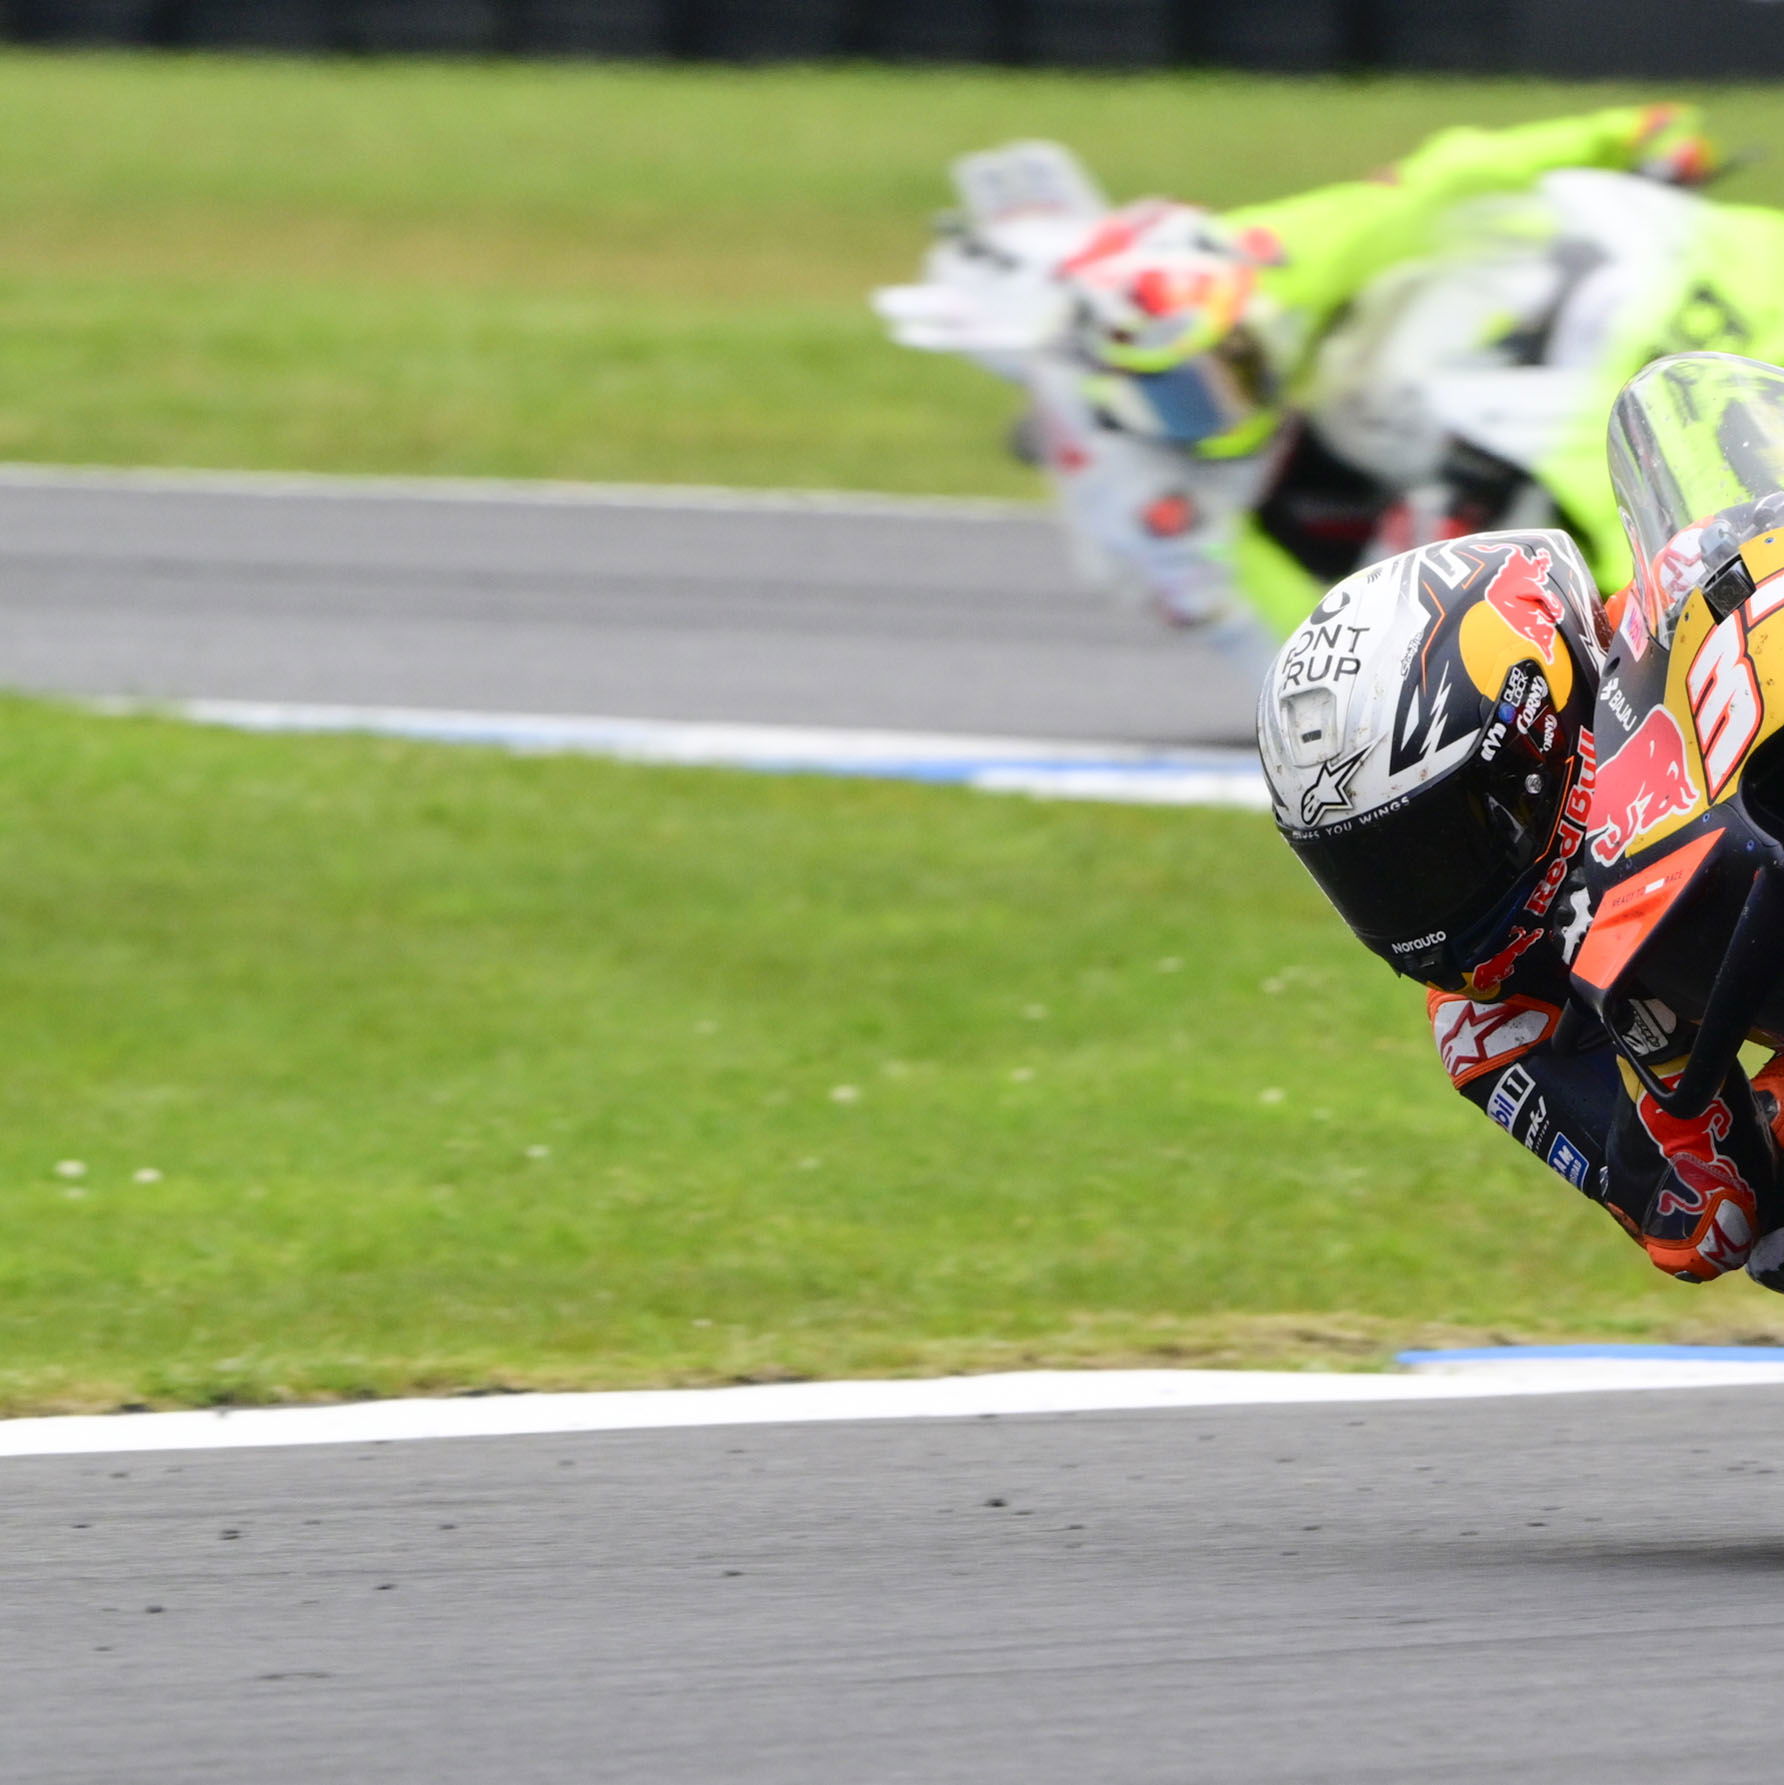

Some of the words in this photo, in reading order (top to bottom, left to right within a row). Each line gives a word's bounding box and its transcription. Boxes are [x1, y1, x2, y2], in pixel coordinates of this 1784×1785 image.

[1503, 666, 1521, 702] QUAD
[1511, 672, 1529, 708] LOCK
[1516, 675, 1549, 735] CORNY
[1608, 691, 1638, 732] BAJAJ
[1540, 714, 1558, 753] ORNY
[1325, 820, 1353, 837] YOU
[1358, 795, 1410, 826] WINGS
[1524, 819, 1586, 917] Red
[1564, 724, 1597, 826] Bull
[1391, 930, 1447, 954] Norauto
[1490, 1093, 1516, 1130] bil
[1506, 1076, 1524, 1094] 1
